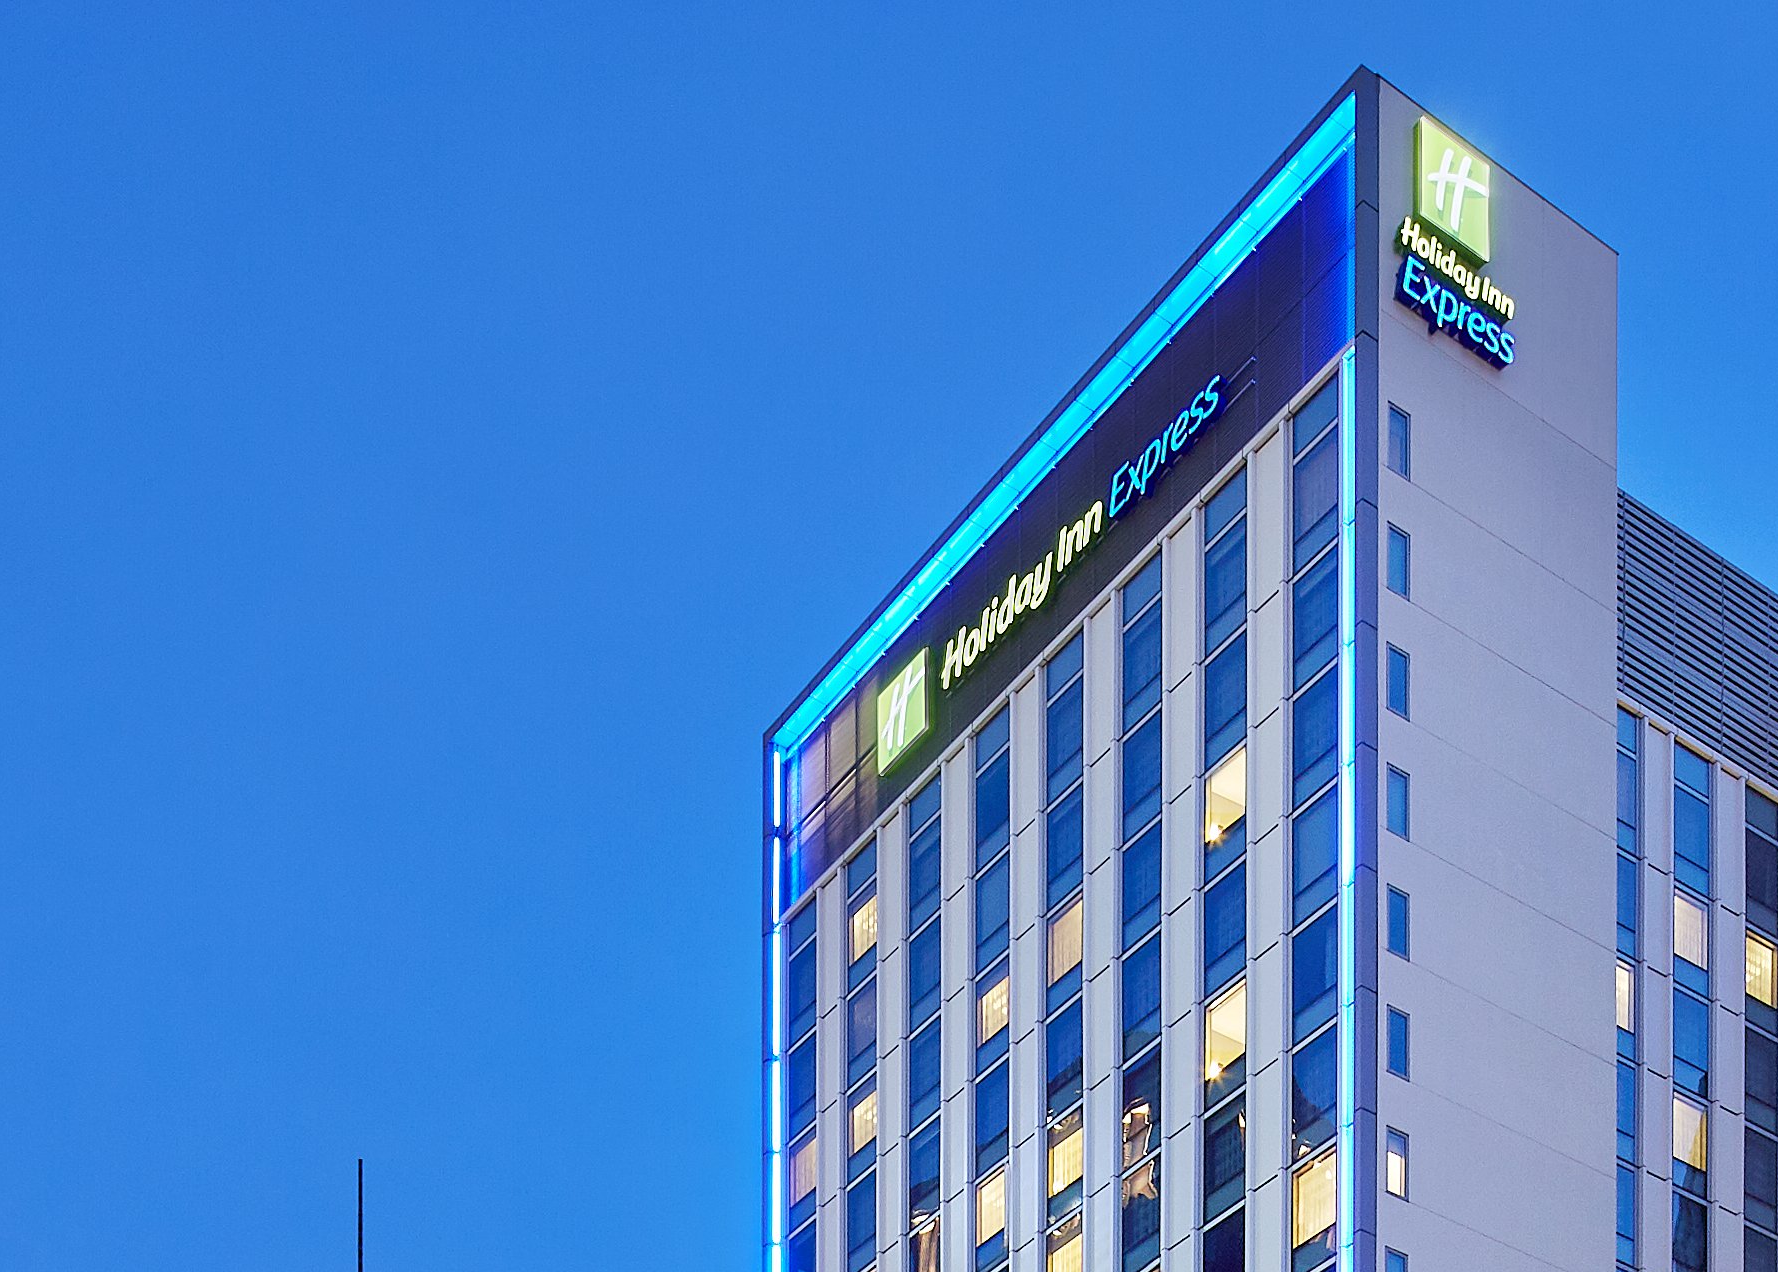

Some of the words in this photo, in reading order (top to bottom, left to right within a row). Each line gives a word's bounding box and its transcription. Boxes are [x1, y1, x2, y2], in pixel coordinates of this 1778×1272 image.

[1400, 215, 1482, 300] Holiday
[1482, 276, 1515, 320] Inn
[1402, 254, 1515, 365] Express
[940, 552, 1053, 690] Holiday
[1055, 500, 1103, 573] Inn
[1108, 374, 1221, 518] Express
